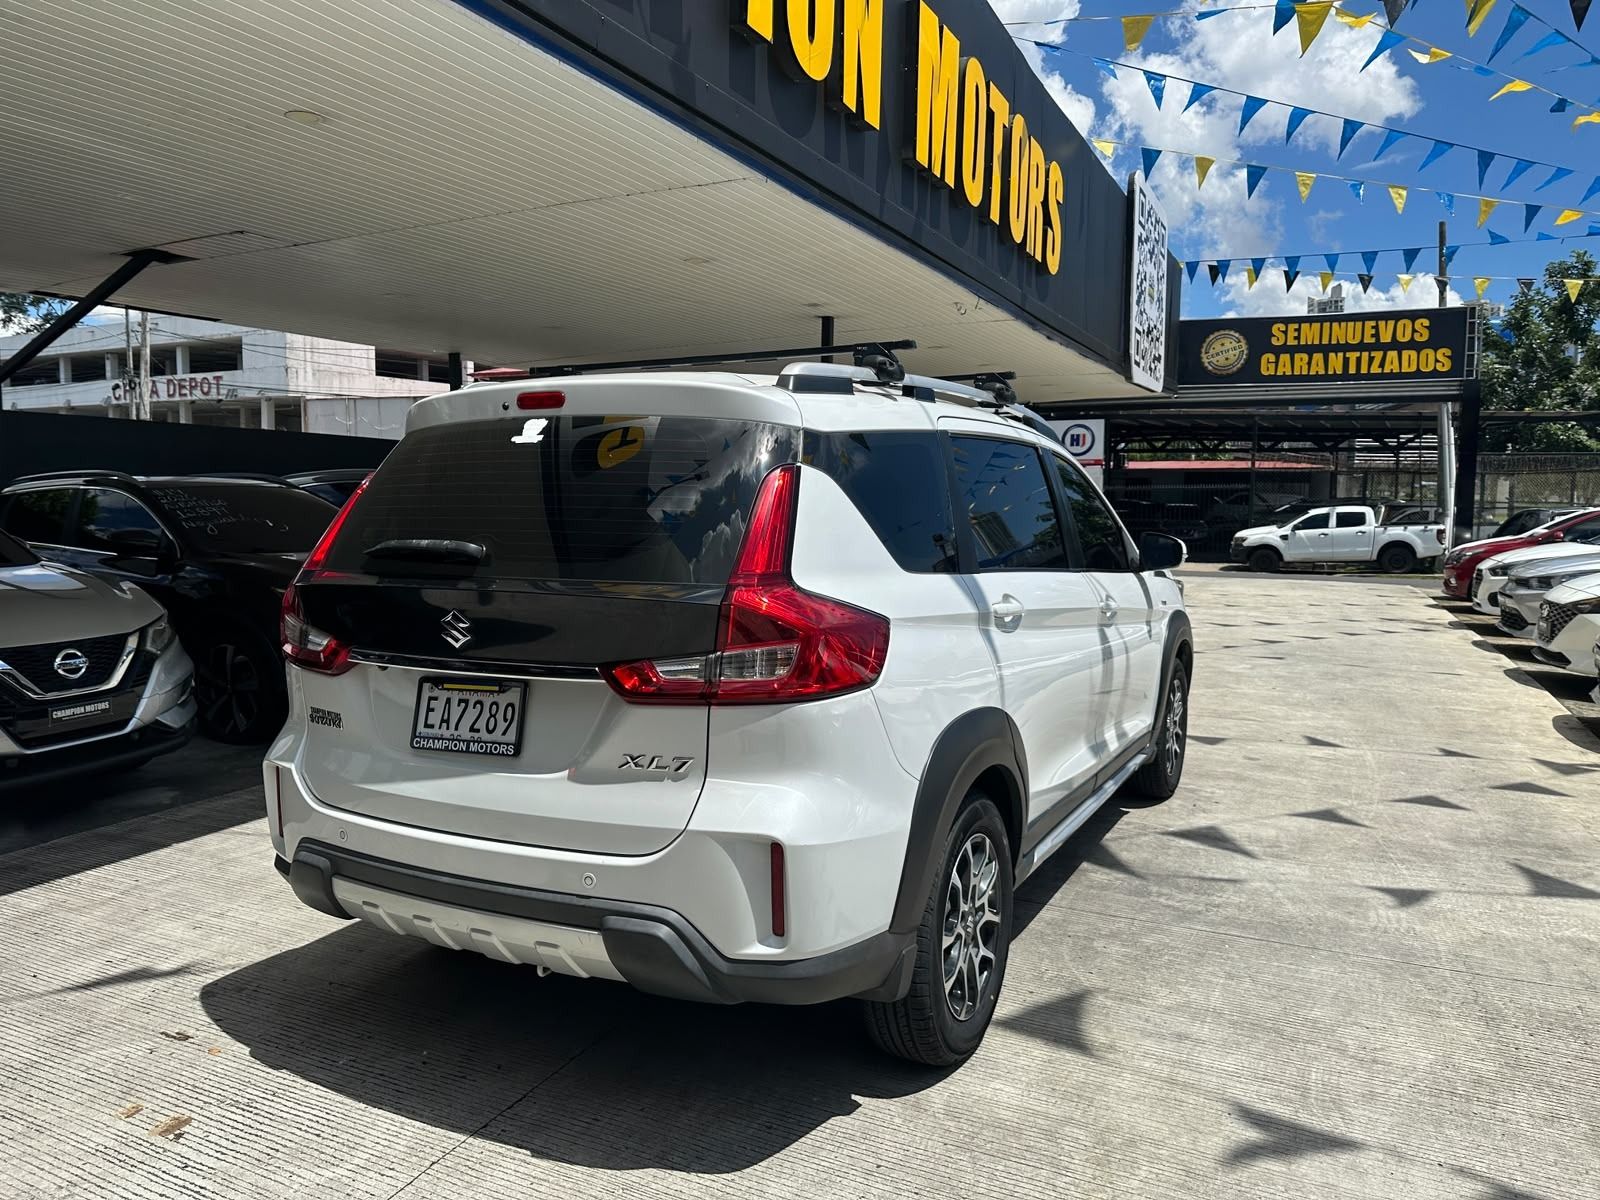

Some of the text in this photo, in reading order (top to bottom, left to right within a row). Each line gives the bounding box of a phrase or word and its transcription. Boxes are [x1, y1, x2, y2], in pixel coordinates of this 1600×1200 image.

[915, 0, 1065, 276] MOTORS
[1270, 318, 1431, 346] SEMINUEVOS
[1206, 344, 1243, 360] CERTIFIED
[1260, 348, 1452, 376] GARANTIZADOS
[166, 375, 223, 398] DEPOT
[52, 701, 110, 719] CHAMPION MOTORS
[423, 695, 516, 737] EA7289
[413, 737, 467, 752] CHAMPION
[469, 741, 515, 756] MOTORS
[617, 753, 695, 773] XL7
